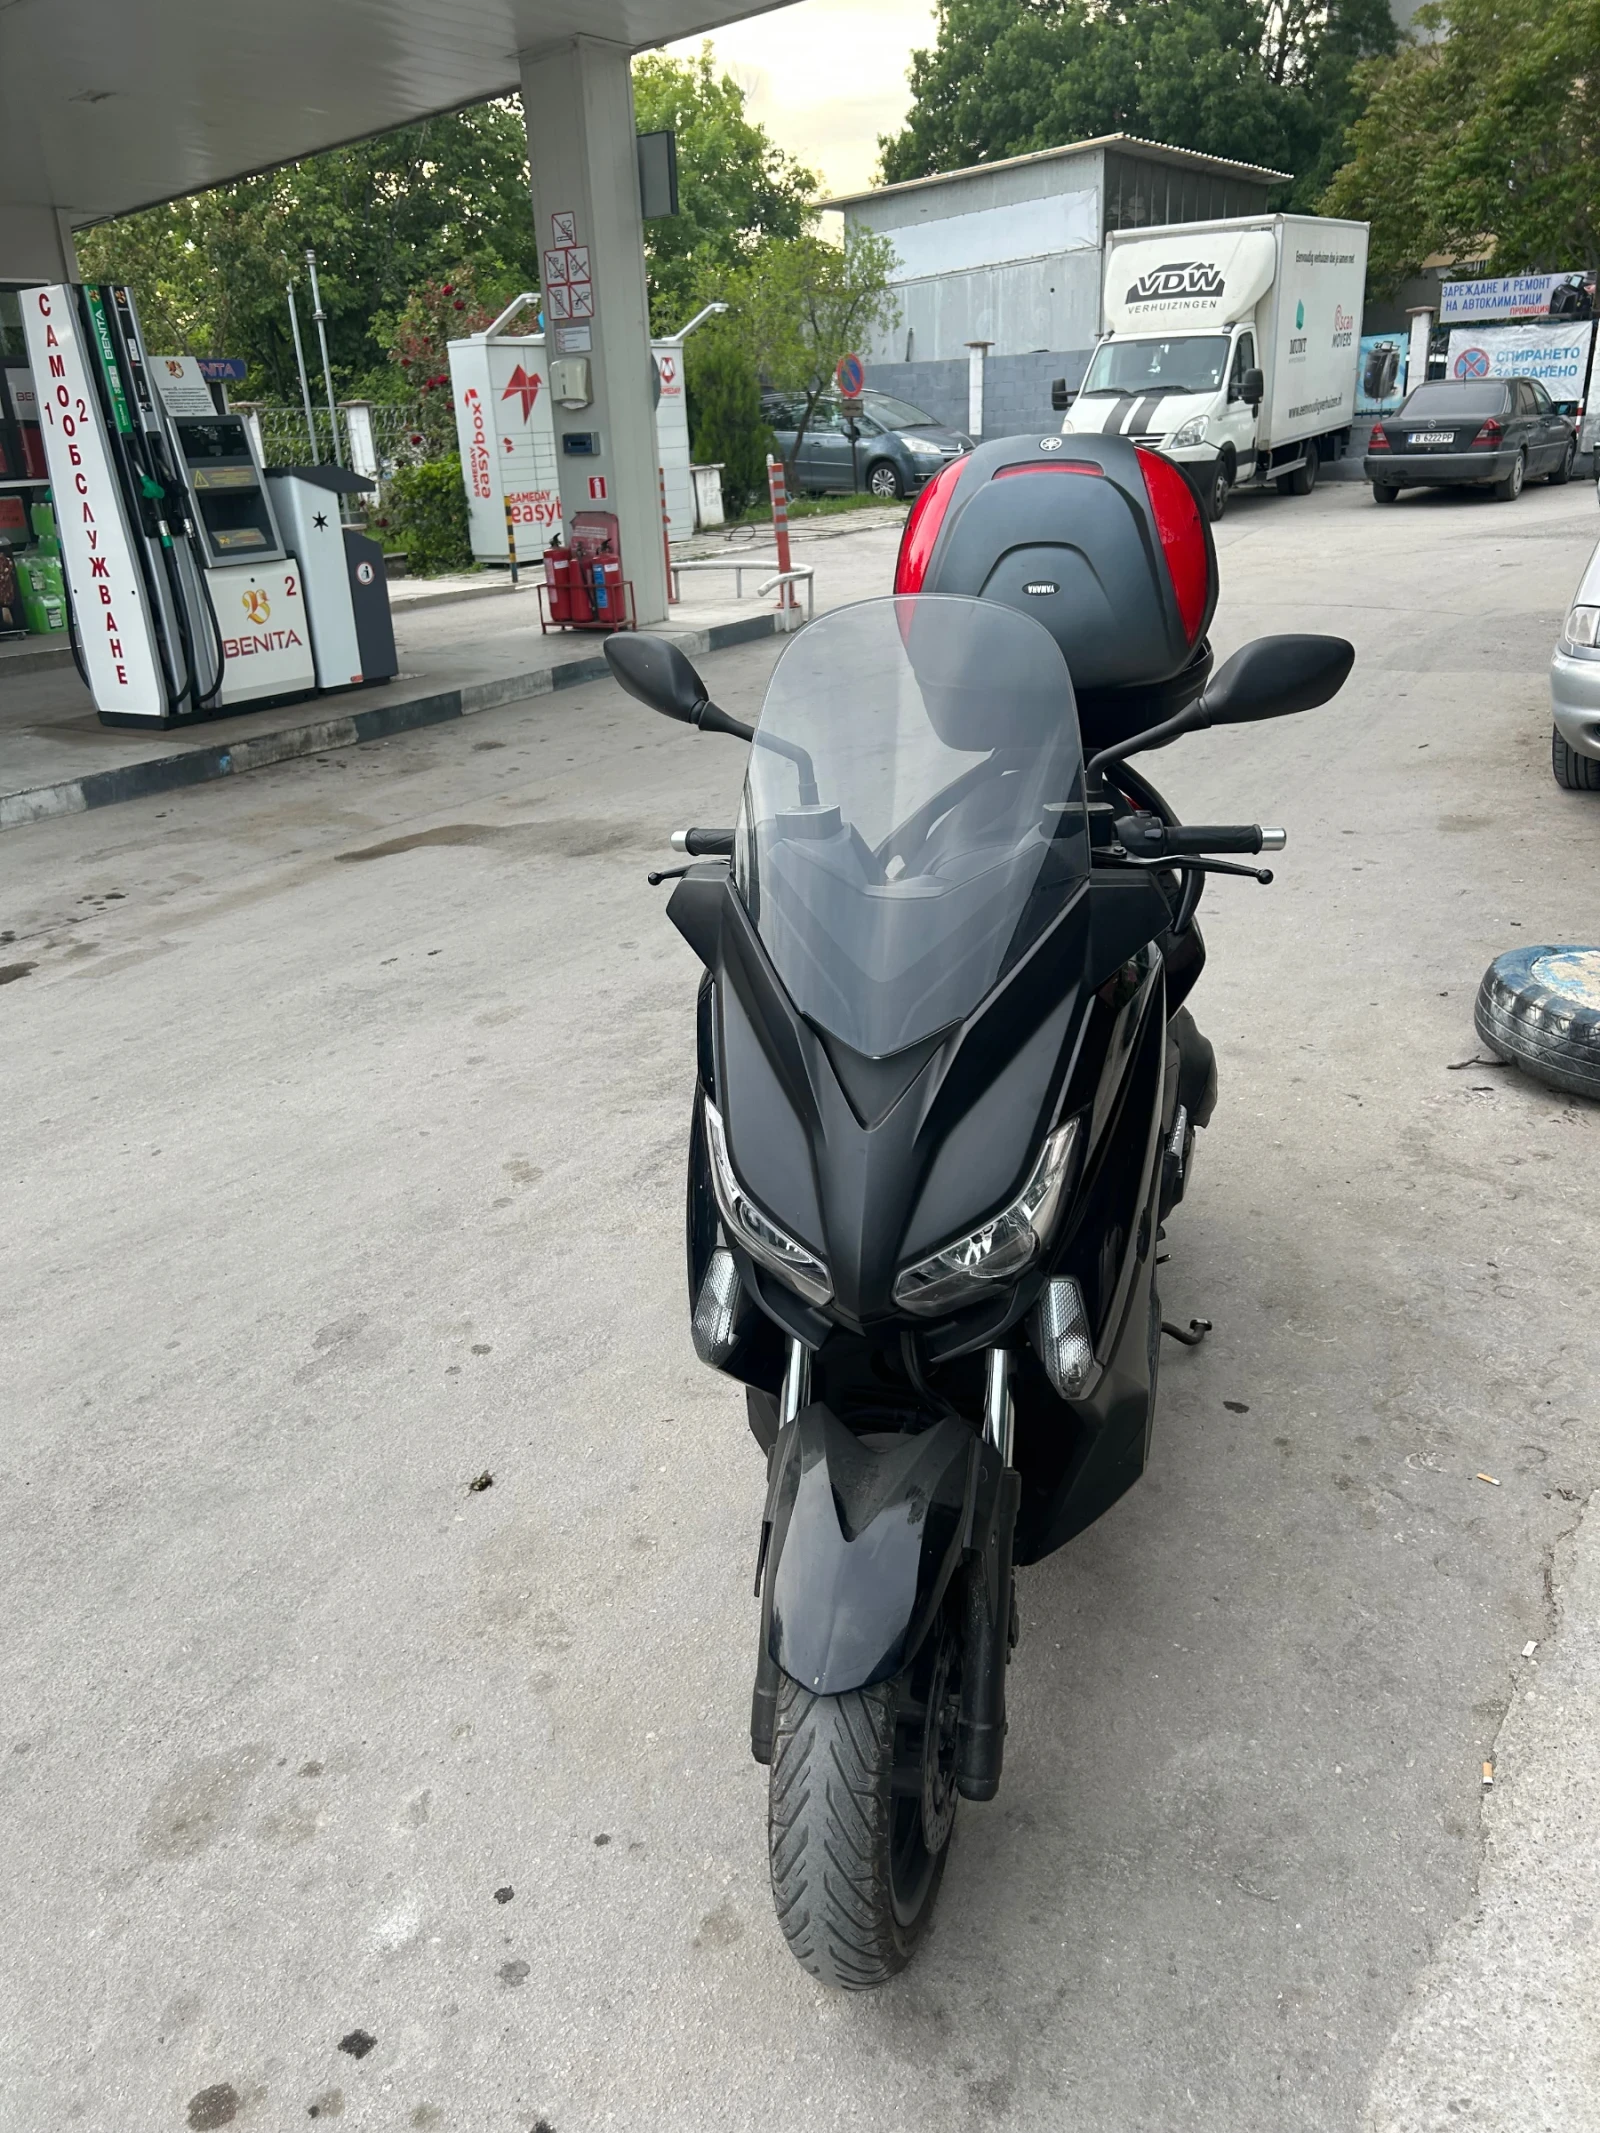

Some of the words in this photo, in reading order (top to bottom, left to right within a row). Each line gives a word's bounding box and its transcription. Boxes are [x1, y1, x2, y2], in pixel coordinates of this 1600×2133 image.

[1138, 269, 1222, 294] VDW
[1442, 281, 1497, 298] ЗАРЕЖДАНЕ
[1503, 280, 1510, 292] И
[1513, 277, 1552, 291] РЕМОНТ
[1128, 300, 1217, 314] VERHUIZINGEN
[1445, 300, 1458, 312] НА
[1462, 293, 1542, 310] АВТОКЛИМАТИЦИ
[1509, 305, 1550, 316] ПРОМОЦИЯ
[95, 309, 114, 360] BENITA
[1496, 346, 1580, 363] СПИРАНЕТО
[197, 362, 236, 378] NITA
[44, 402, 54, 425] 1
[76, 399, 88, 423] 2
[472, 402, 492, 499] easybox
[469, 447, 481, 498] SAMEDAY
[509, 491, 551, 504] SAMEDAY
[284, 576, 297, 597] 2
[1027, 585, 1055, 594] YAMAHA
[223, 629, 303, 660] BENITA
